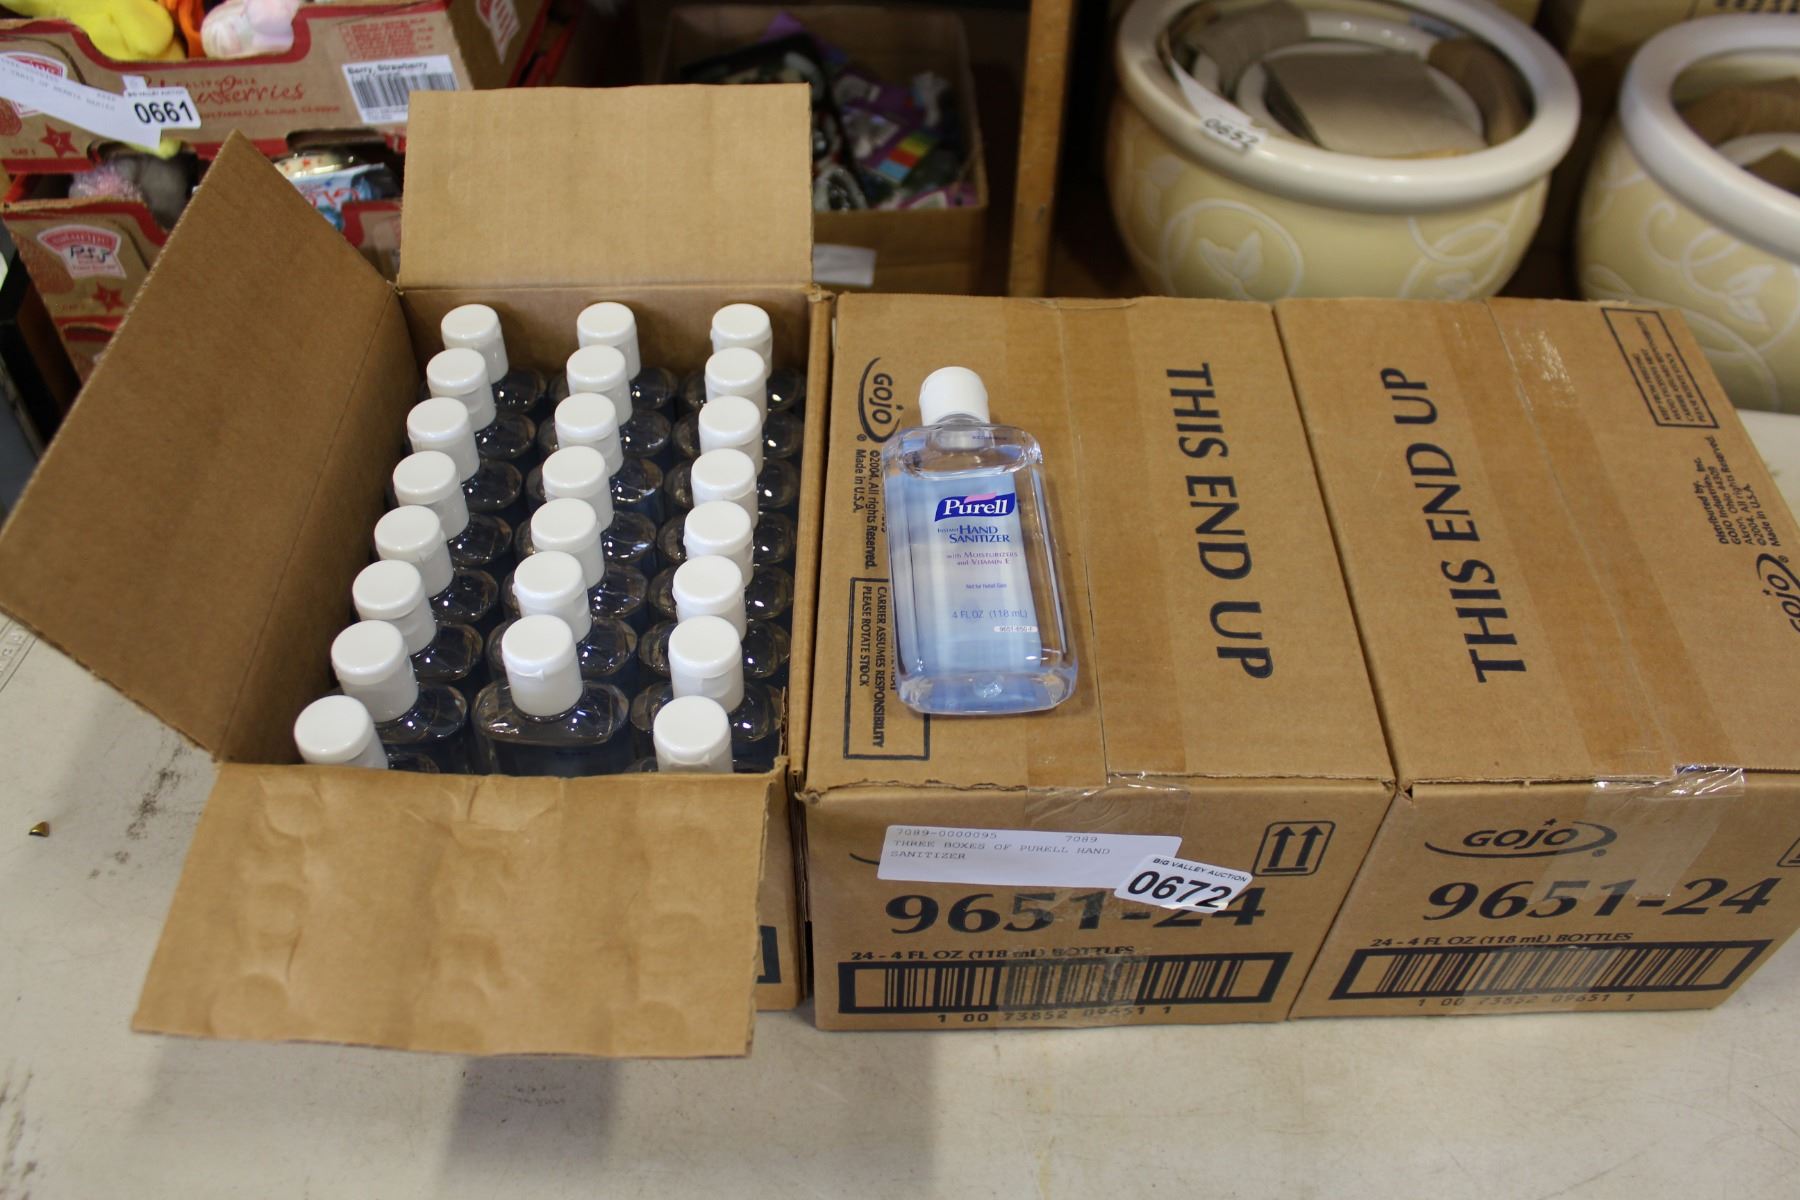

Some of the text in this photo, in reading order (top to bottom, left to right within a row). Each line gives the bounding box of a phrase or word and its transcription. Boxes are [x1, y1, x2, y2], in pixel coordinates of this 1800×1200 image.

[134, 101, 194, 124] 0661
[869, 373, 903, 424] GOJO
[855, 449, 866, 474] Made
[852, 487, 865, 513] U.S.A.
[868, 482, 879, 495] All
[865, 497, 879, 523] rights
[942, 499, 1008, 515] Purell
[1697, 495, 1729, 544] Distributed
[1756, 510, 1767, 520] in
[959, 525, 998, 534] HAND
[1166, 362, 1274, 679] THIS END UP
[1380, 367, 1527, 683] THIS END UP
[1722, 520, 1741, 544] GOJO
[949, 534, 1010, 544] SANITIZER
[1762, 521, 1781, 546] Made
[865, 525, 878, 570] Reserved.
[859, 586, 872, 687] PLEASE ROTATE STOCK
[872, 586, 887, 748] CARRIER ASSUMES RESPONSIBILITY
[1065, 835, 1098, 843] 7089
[1462, 818, 1579, 850] GOJO
[890, 850, 966, 860] SANITIZER
[894, 839, 935, 848] THREE
[944, 841, 985, 850] BOXES
[1020, 845, 1069, 854] PURELL
[1077, 847, 1111, 855] HAND
[1171, 861, 1207, 873] VALLEY
[1128, 871, 1232, 909] 0672
[1422, 877, 1783, 921] 9651-24
[1370, 938, 1392, 947] 24
[1408, 938, 1419, 946] 4
[1424, 937, 1441, 946] FL
[1448, 936, 1475, 945] OZ
[1480, 935, 1517, 945] (118
[1556, 932, 1634, 943] BOTTLES
[851, 951, 873, 960] 24
[891, 951, 902, 960] 4
[908, 950, 928, 960] FL
[934, 950, 963, 960] OZ
[969, 949, 1007, 960] (118
[1051, 945, 1135, 957] BOTTLES
